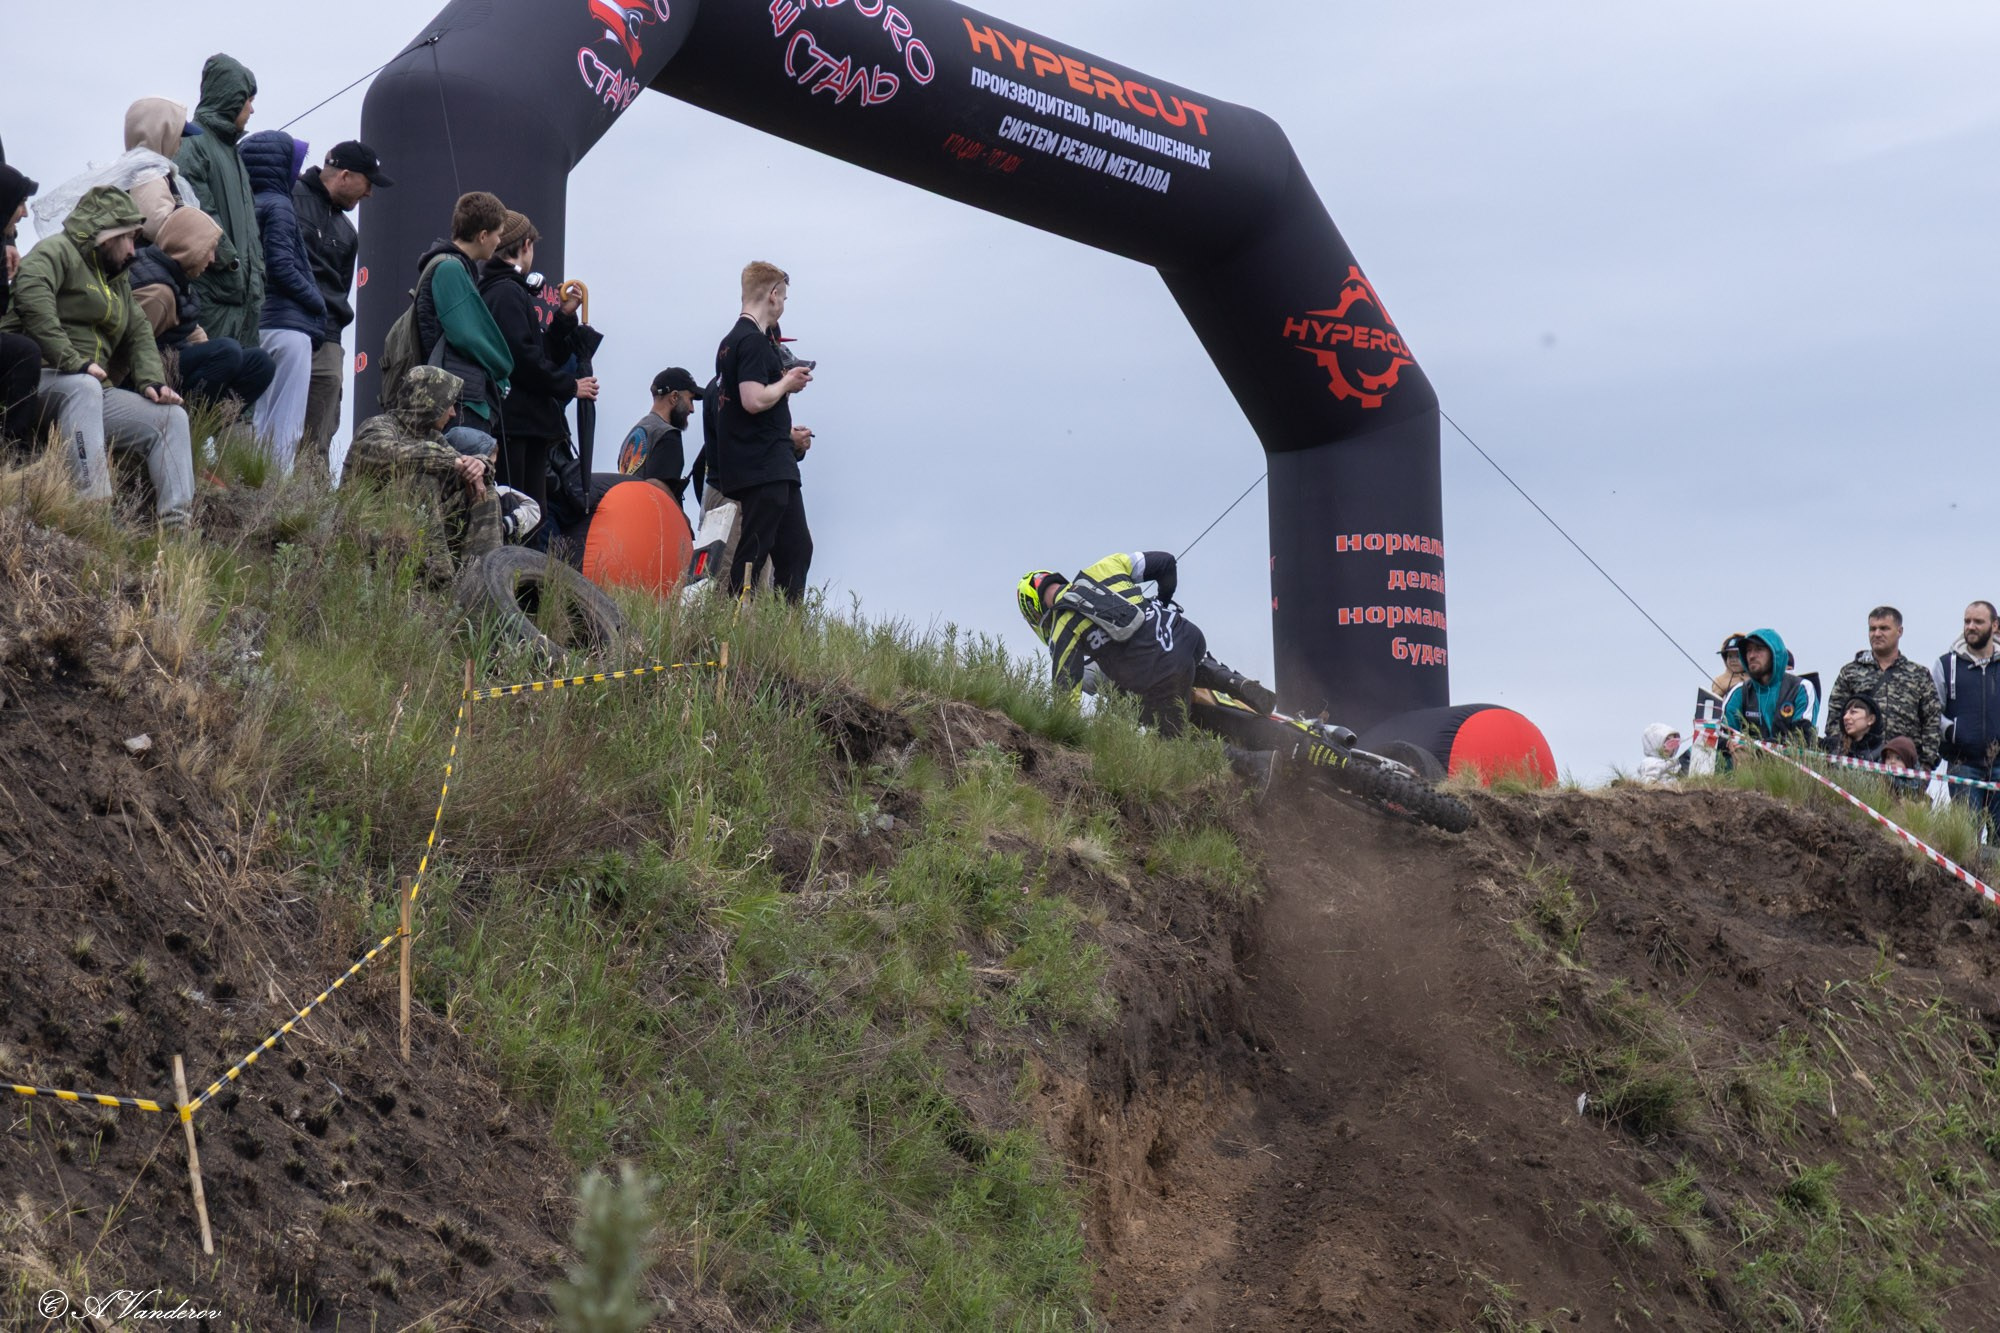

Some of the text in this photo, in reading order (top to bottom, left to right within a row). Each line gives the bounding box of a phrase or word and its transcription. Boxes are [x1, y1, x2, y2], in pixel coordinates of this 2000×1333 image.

[962, 17, 1208, 136] HYPERCUT
[971, 67, 1091, 127] ПРОИЗВОДИТЕЛЬ
[1093, 112, 1211, 170] ПРОМЫШЛЕННЫХ
[998, 115, 1060, 155] СИСТЕМ
[1058, 138, 1107, 172] РЕЗКИ
[1104, 152, 1172, 194] МЕТАЛЛА
[1391, 636, 1447, 666] будет
